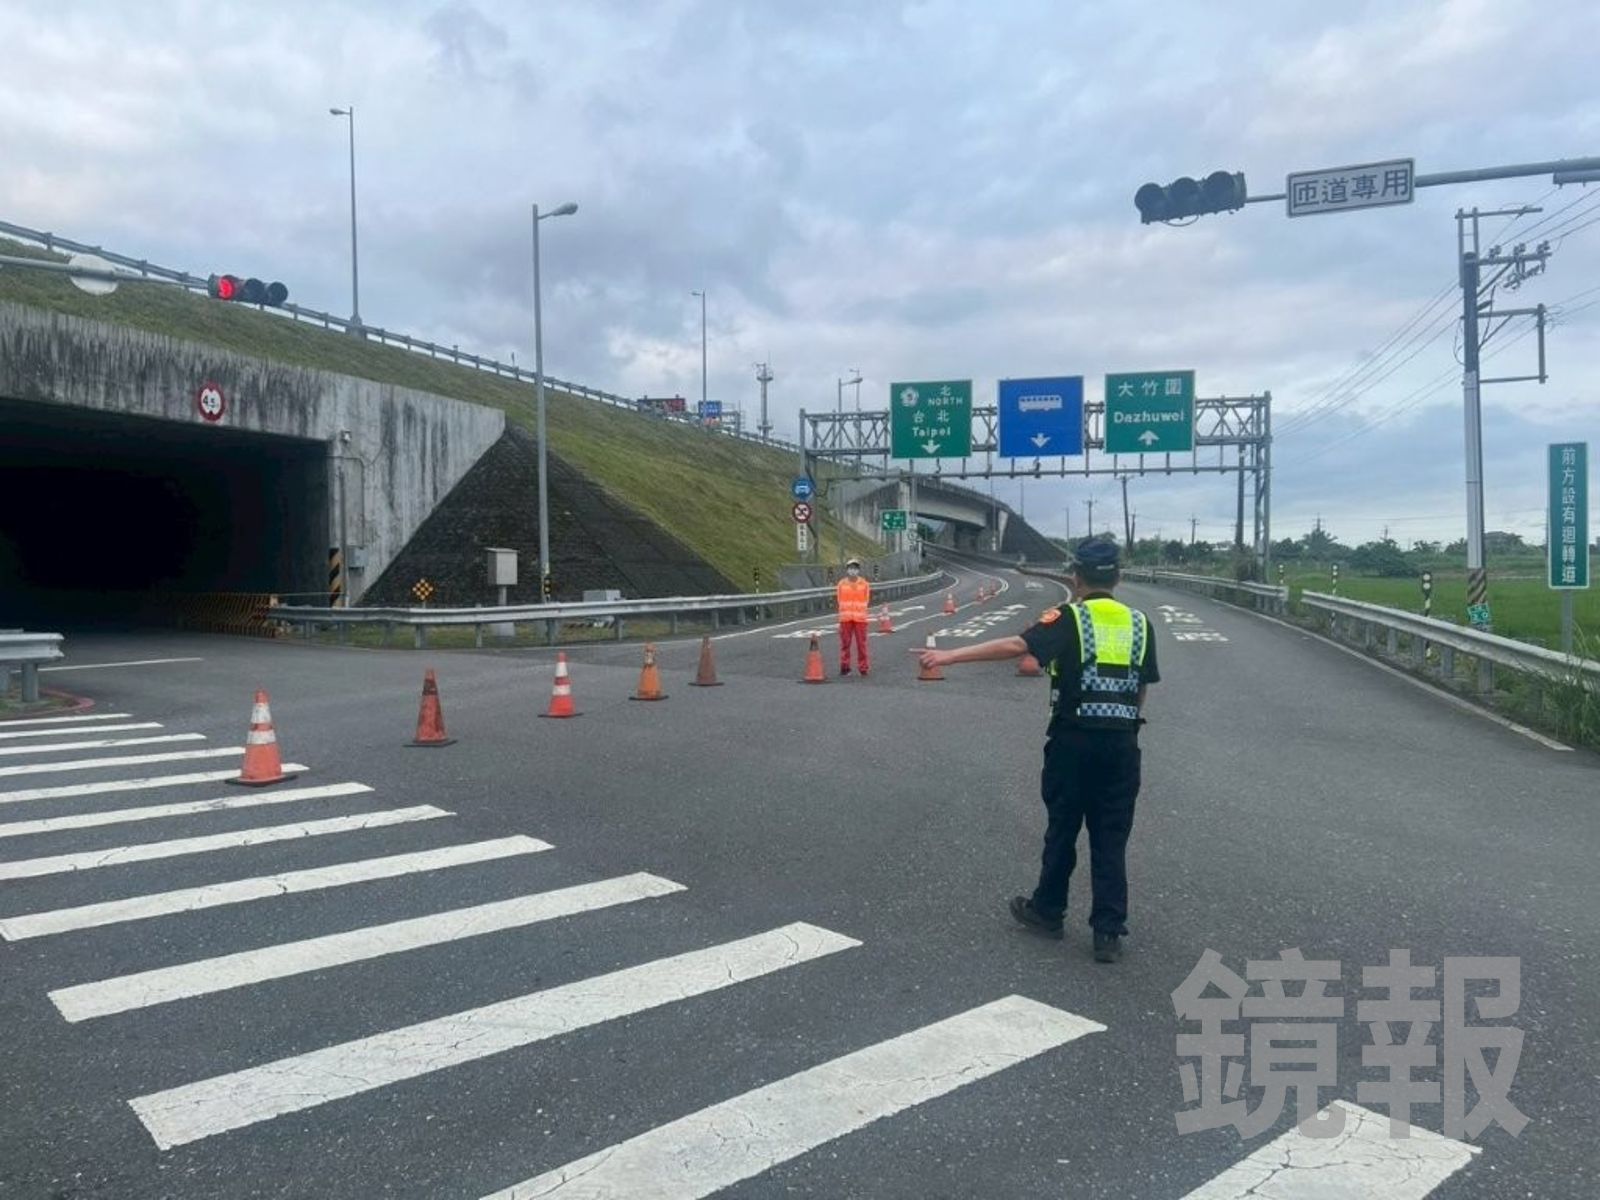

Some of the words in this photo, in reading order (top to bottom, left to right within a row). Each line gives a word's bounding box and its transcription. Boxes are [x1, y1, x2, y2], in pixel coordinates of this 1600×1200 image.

[1293, 169, 1409, 208] 匝道專用
[940, 385, 951, 396] 北
[1118, 378, 1182, 397] 大竹圍
[927, 396, 964, 406] NORTH
[913, 410, 949, 423] 台北
[1113, 408, 1184, 424] Dazhuwei
[911, 426, 951, 438] Taipei
